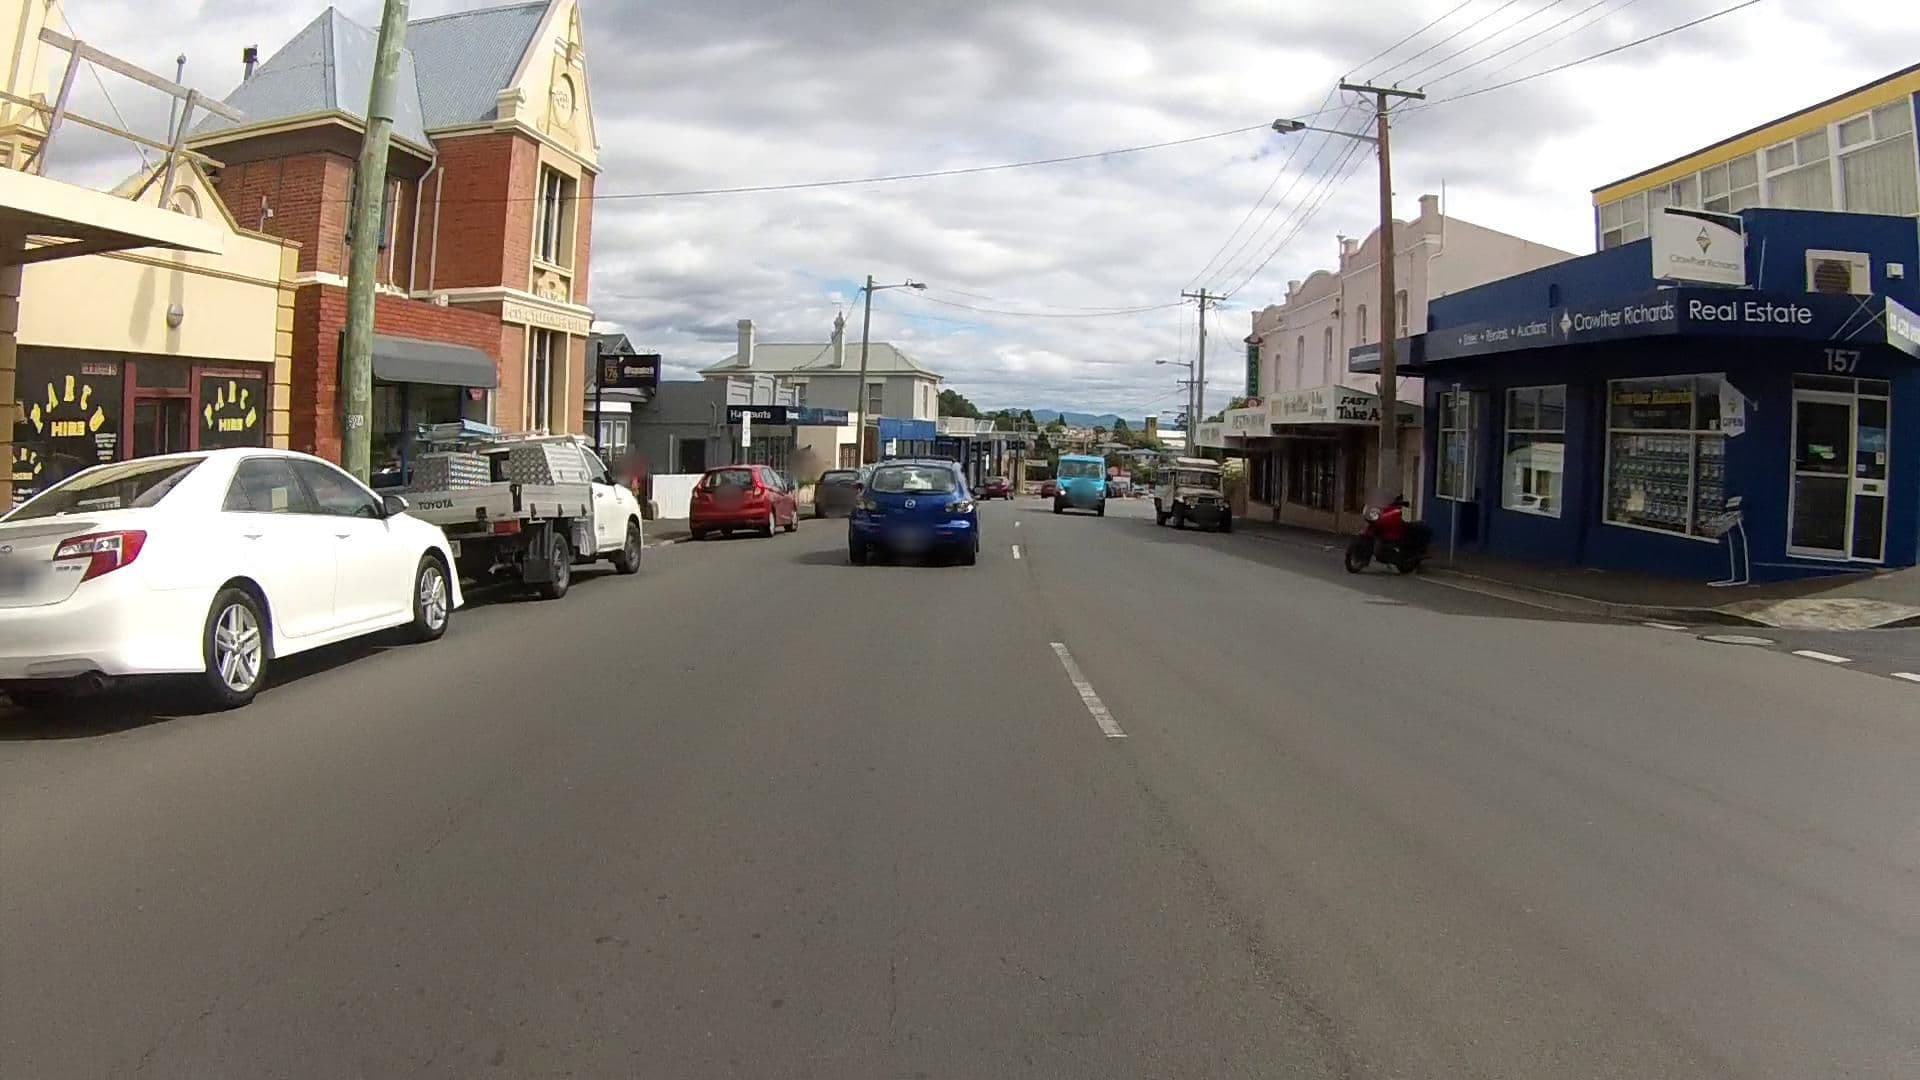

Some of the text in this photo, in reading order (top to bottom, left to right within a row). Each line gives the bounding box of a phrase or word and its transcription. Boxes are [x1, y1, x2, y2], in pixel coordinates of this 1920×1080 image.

[1517, 320, 1548, 338] Auctions
[1574, 311, 1621, 332] Crowther
[1624, 300, 1675, 325] Richards
[1689, 299, 1812, 325] Real Estate
[1824, 348, 1860, 373] 157
[1340, 396, 1369, 406] FAST
[1336, 406, 1367, 421] Take
[50, 421, 86, 437] HIRE
[218, 418, 244, 432] HIRE
[418, 499, 454, 511] TOYOTA
